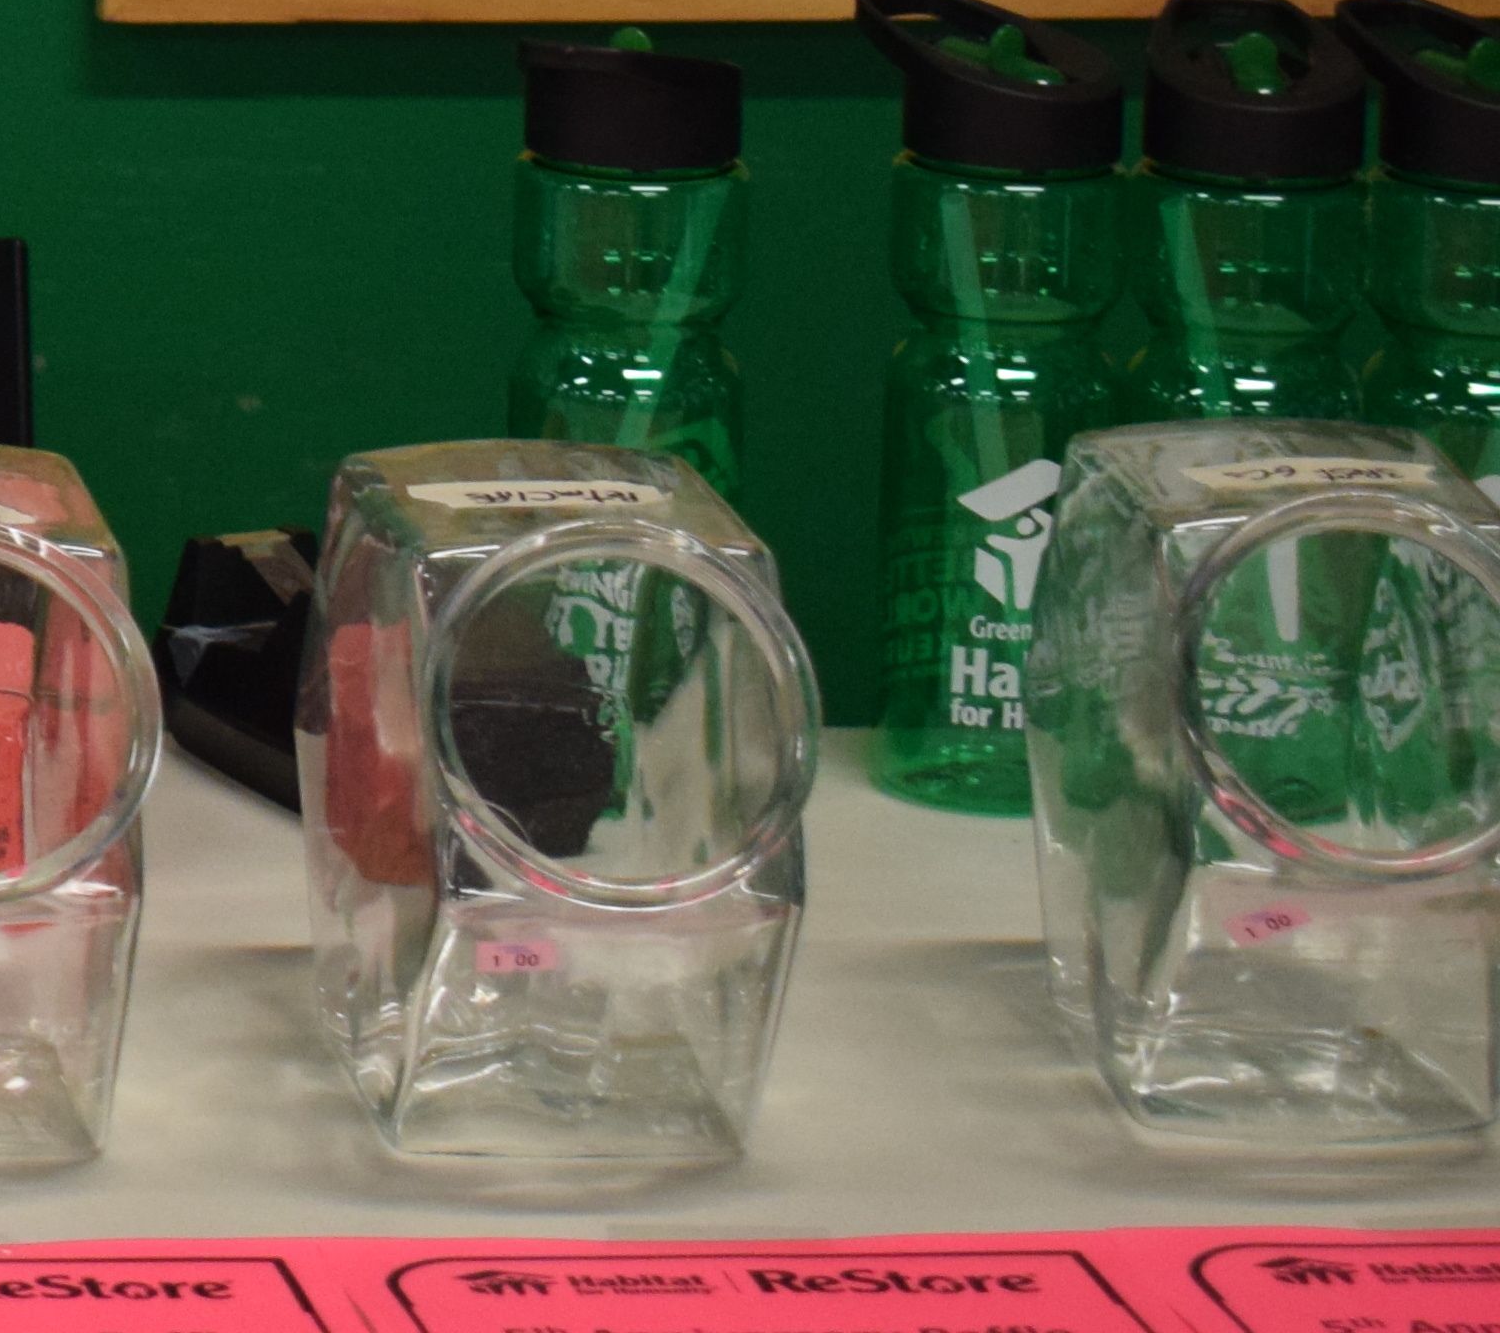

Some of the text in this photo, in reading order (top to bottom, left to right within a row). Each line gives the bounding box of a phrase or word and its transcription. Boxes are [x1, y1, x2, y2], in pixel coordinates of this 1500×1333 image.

[969, 614, 1033, 641] Green
[950, 696, 994, 728] for
[746, 1269, 1041, 1295] ReStore
